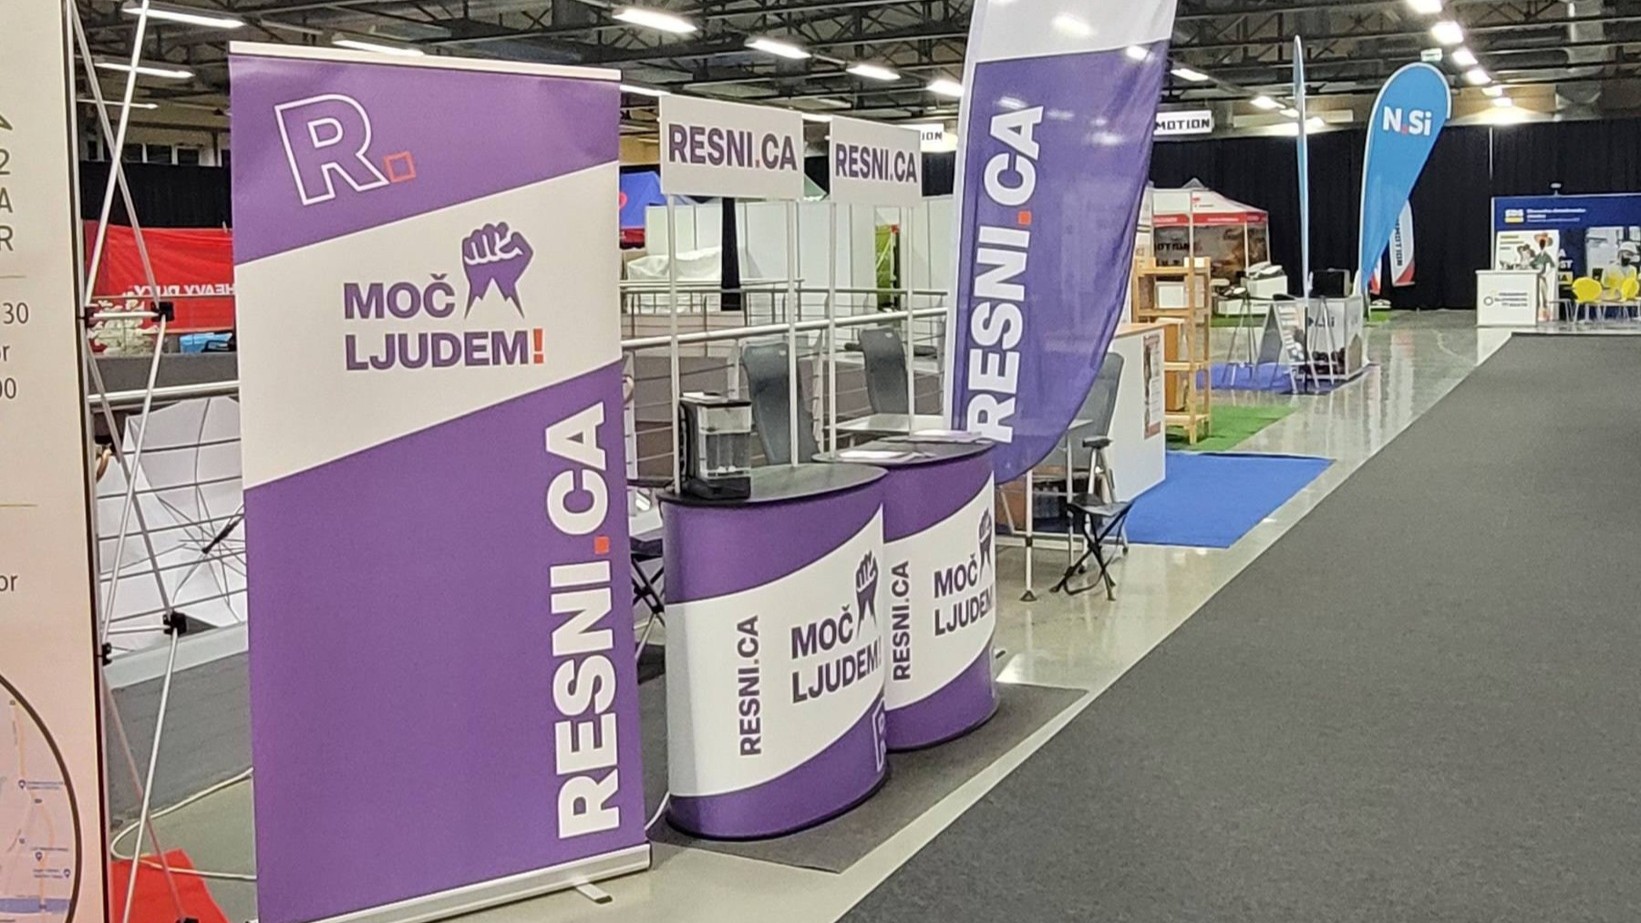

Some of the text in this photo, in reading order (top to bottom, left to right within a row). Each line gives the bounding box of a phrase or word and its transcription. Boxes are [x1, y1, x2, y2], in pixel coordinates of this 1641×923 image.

[1382, 105, 1433, 136] N.Si
[668, 124, 798, 171] RESNI.CA
[835, 143, 918, 183] RESNI.CA
[344, 273, 455, 320] MOČ
[967, 105, 1043, 443] RESNI.CA
[345, 328, 545, 371] LJUDEM!
[934, 554, 978, 598] MOČ
[544, 402, 621, 838] RESNI.CA
[790, 603, 853, 659] MOČ
[891, 560, 912, 682] RESNI.CA
[737, 615, 762, 756] RESNI.CA
